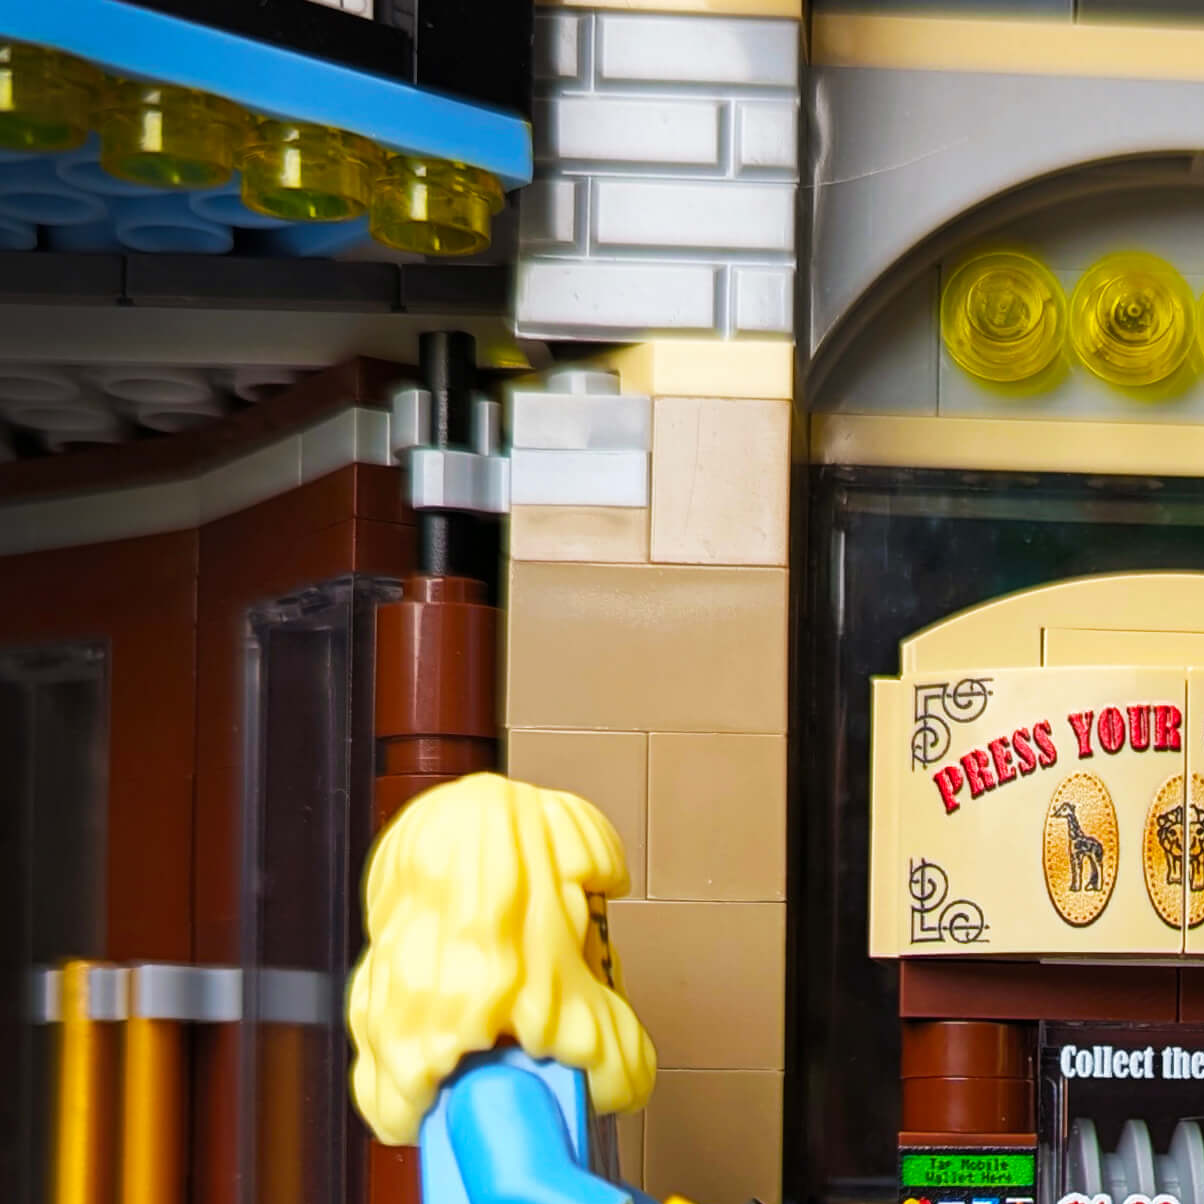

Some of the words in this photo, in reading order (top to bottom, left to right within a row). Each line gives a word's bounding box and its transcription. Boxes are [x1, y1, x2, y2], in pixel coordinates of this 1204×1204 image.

[932, 720, 1060, 815] PRESS
[1067, 704, 1182, 760] YOUR
[1060, 1045, 1155, 1080] Collect
